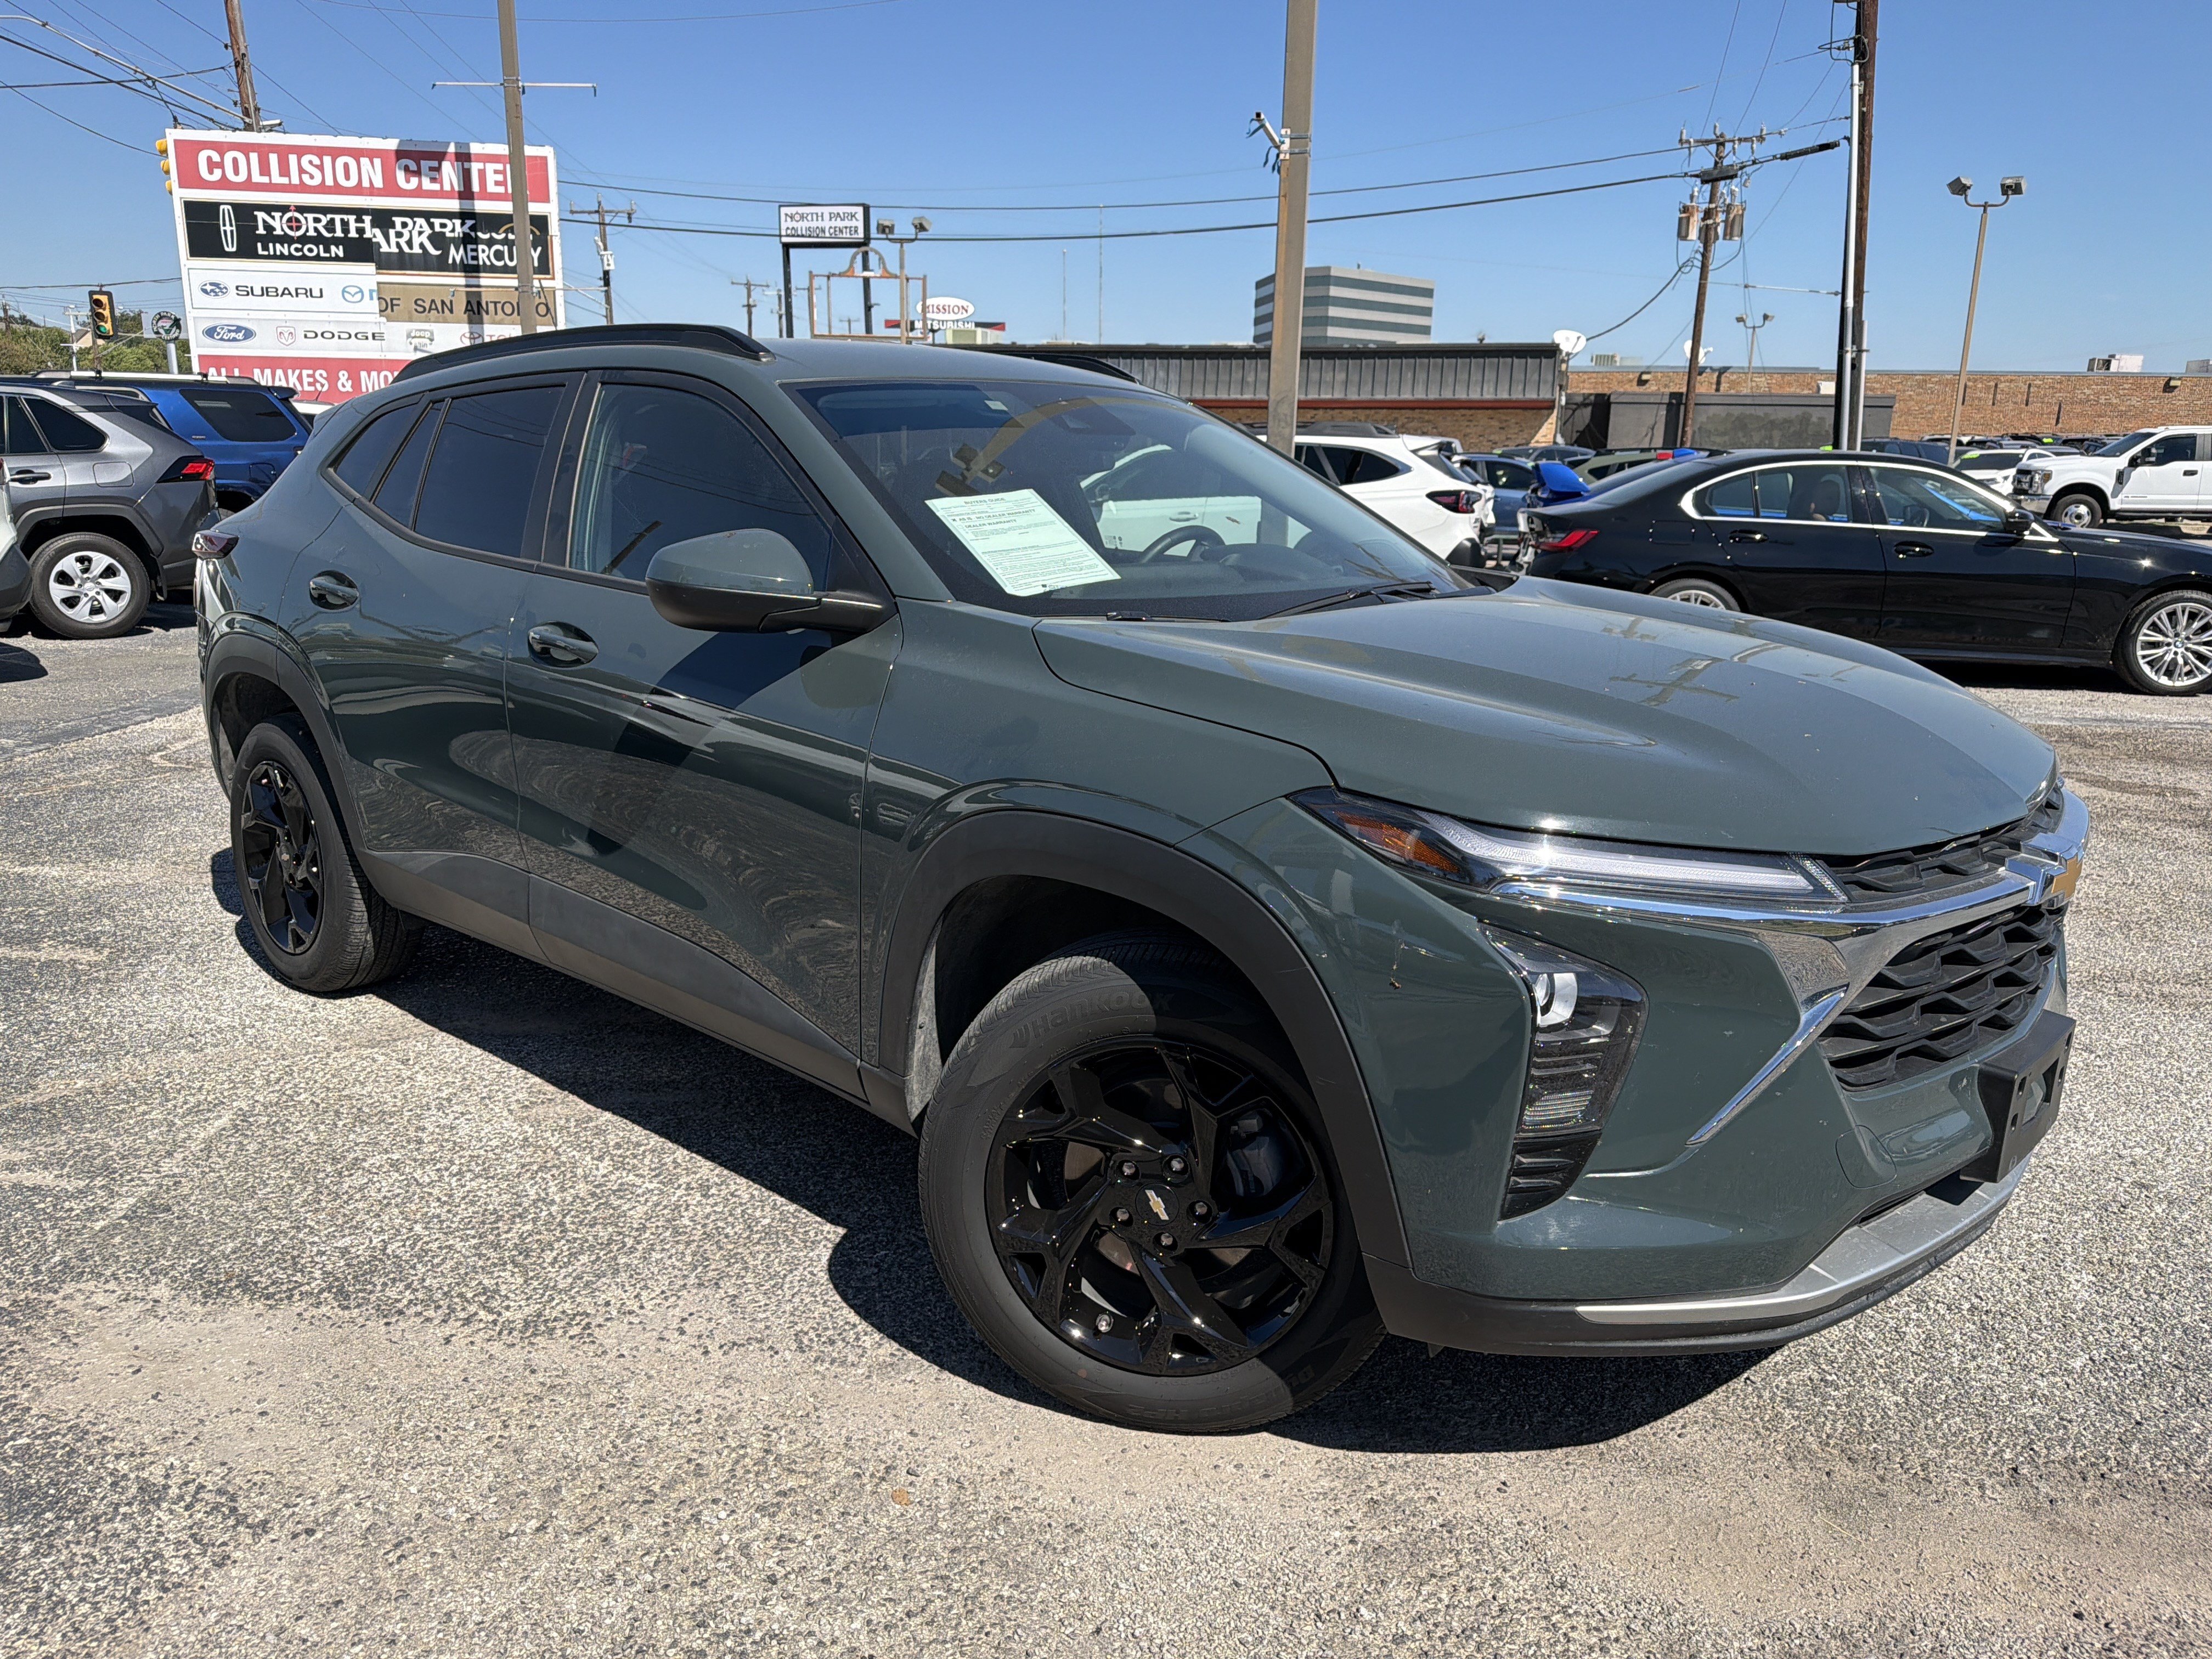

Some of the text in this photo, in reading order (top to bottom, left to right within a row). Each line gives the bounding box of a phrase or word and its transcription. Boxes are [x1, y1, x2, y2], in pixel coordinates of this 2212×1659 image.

[198, 149, 384, 188] COLLISION
[253, 208, 373, 239] NORTH
[784, 211, 860, 222] NORTH PARK
[785, 225, 859, 236] COLLISION CENTER
[257, 242, 344, 257] LINCOLN
[448, 243, 542, 267] MERCUY
[235, 285, 324, 299] SUBARU
[378, 297, 550, 318] OF SAN ANTOO
[160, 312, 175, 320] PARK
[914, 320, 975, 330] MTSUBISHI
[215, 325, 245, 341] Ford
[303, 330, 386, 341] DODGE
[410, 329, 431, 338] Jeep
[253, 368, 329, 392] MAKES
[337, 370, 354, 392] &
[360, 370, 400, 392] MO
